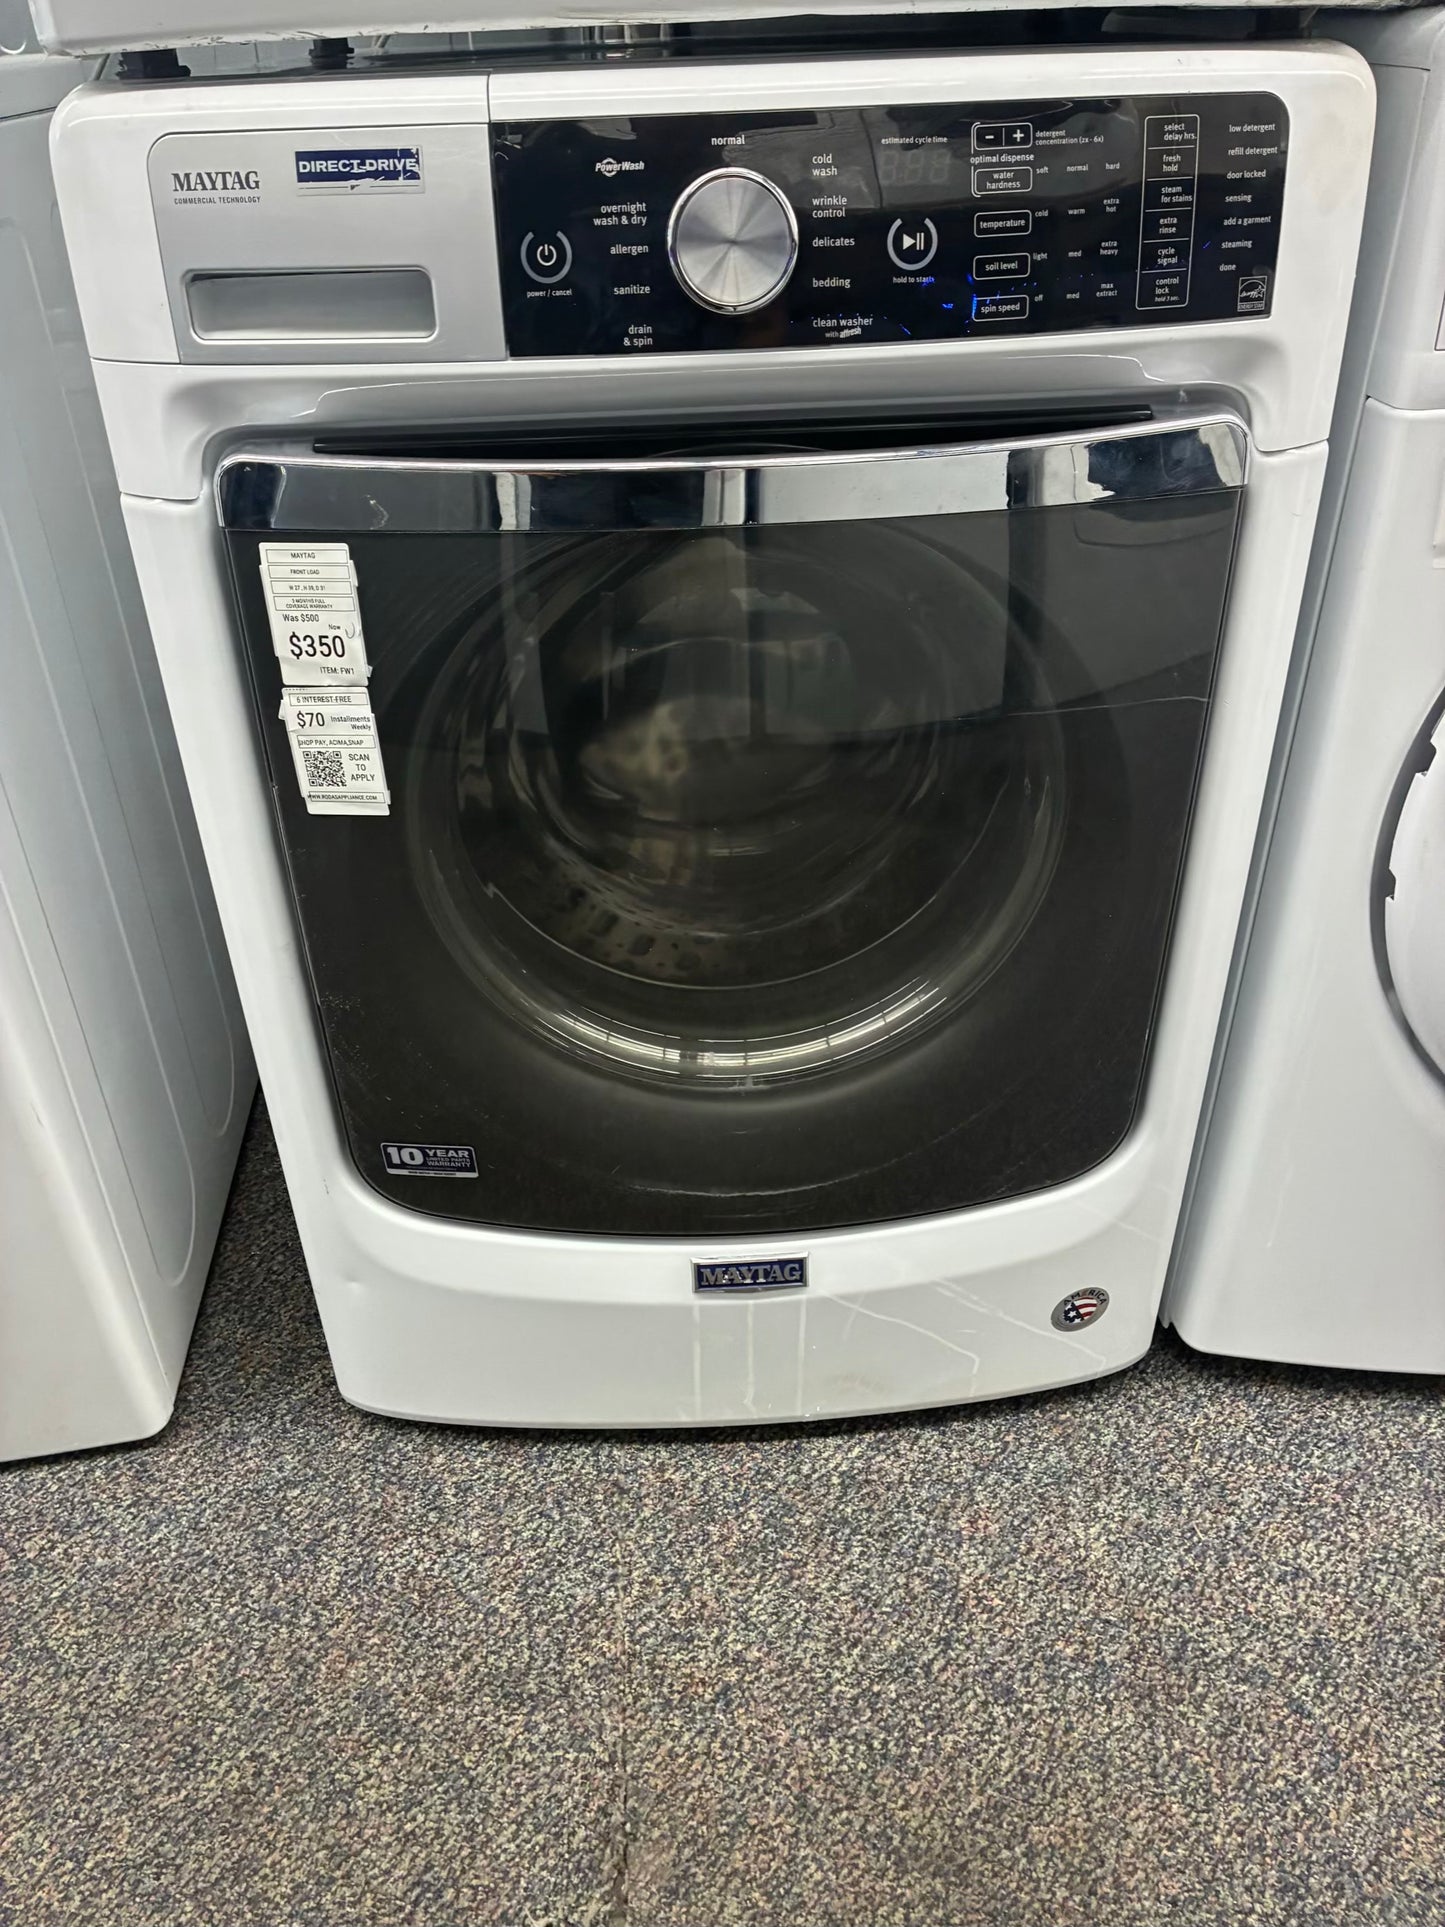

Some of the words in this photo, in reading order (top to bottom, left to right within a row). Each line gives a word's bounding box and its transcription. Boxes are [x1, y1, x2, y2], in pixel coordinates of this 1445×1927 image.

[1164, 123, 1185, 131] select
[1229, 124, 1241, 132] low
[1243, 123, 1276, 133] detergent
[1036, 130, 1065, 138] detergent
[1164, 132, 1183, 142] delay
[1184, 131, 1198, 140] hrs.
[711, 135, 746, 146] normal
[881, 137, 914, 145] estimated
[915, 137, 931, 145] cycle
[932, 135, 948, 143] time
[1036, 137, 1078, 146] concentration
[1228, 147, 1244, 156] refill
[1245, 146, 1278, 156] detergent
[812, 153, 832, 164] cold
[970, 154, 999, 164] optimal
[1001, 153, 1034, 164] dispense
[1163, 154, 1181, 163] fresh
[299, 159, 360, 174] DIRECT
[365, 158, 418, 172] DRIVE
[595, 160, 645, 173] PowerWash
[812, 166, 838, 176] wash
[1036, 166, 1049, 174] soft
[1066, 164, 1089, 172] normal
[1162, 164, 1178, 172] hold
[992, 172, 1015, 180] water
[1226, 170, 1243, 179] door
[1244, 169, 1266, 178] locked
[172, 170, 261, 192] MAYTAG
[986, 180, 1021, 190] hardness
[1161, 186, 1182, 194] steam
[174, 197, 217, 205] COMMERCIAL
[219, 196, 261, 204] TECHNOLOGY
[812, 196, 847, 206] wrinkle
[1103, 198, 1119, 206] extra
[1161, 195, 1171, 204] for
[1172, 194, 1192, 203] stains
[1225, 194, 1252, 204] sensing
[600, 202, 647, 215] overnight
[812, 208, 846, 218] control
[1035, 209, 1049, 217] cold
[593, 216, 619, 226] wash
[621, 215, 629, 225] &
[631, 215, 647, 227] dry
[980, 219, 1026, 230] temperature
[1159, 217, 1177, 225] extra
[1223, 217, 1236, 226] add
[1243, 216, 1271, 225] garment
[1159, 226, 1176, 234] rinse
[812, 237, 855, 248] delicates
[1101, 240, 1117, 248] extra
[1221, 239, 1252, 249] steaming
[610, 244, 649, 256] allergen
[1100, 248, 1118, 257] heavy
[1157, 246, 1175, 256] cycle
[1033, 252, 1048, 261] light
[1157, 255, 1178, 266] signal
[985, 262, 999, 271] soil
[1000, 261, 1018, 270] level
[1219, 263, 1236, 271] done
[812, 278, 851, 288] bedding
[893, 276, 907, 284] hold
[1155, 276, 1179, 286] control
[527, 290, 546, 298] power
[552, 288, 572, 297] cancel
[614, 285, 651, 295] sanitize
[1096, 289, 1117, 298] extract
[1155, 286, 1169, 295] lock
[1034, 294, 1043, 302] off
[1066, 292, 1080, 300] med
[981, 304, 997, 314] spin
[998, 302, 1020, 313] speed
[812, 317, 837, 327] clean
[839, 316, 873, 326] washer
[628, 324, 653, 334] drain
[825, 330, 839, 338] with
[624, 337, 631, 346] &
[633, 336, 653, 348] spin
[282, 613, 299, 622] Was
[300, 613, 320, 623] $500
[289, 631, 346, 660] $350
[320, 666, 339, 675] ITEM:
[340, 666, 355, 675] FW1
[296, 710, 325, 729] $70
[351, 723, 371, 731] Weekly
[348, 753, 370, 761] SCAN
[356, 763, 367, 771] TO
[351, 774, 375, 782] APPLY
[387, 1147, 424, 1165] 10
[425, 1149, 470, 1157] YEAR
[700, 1263, 802, 1286] MAYTAG
